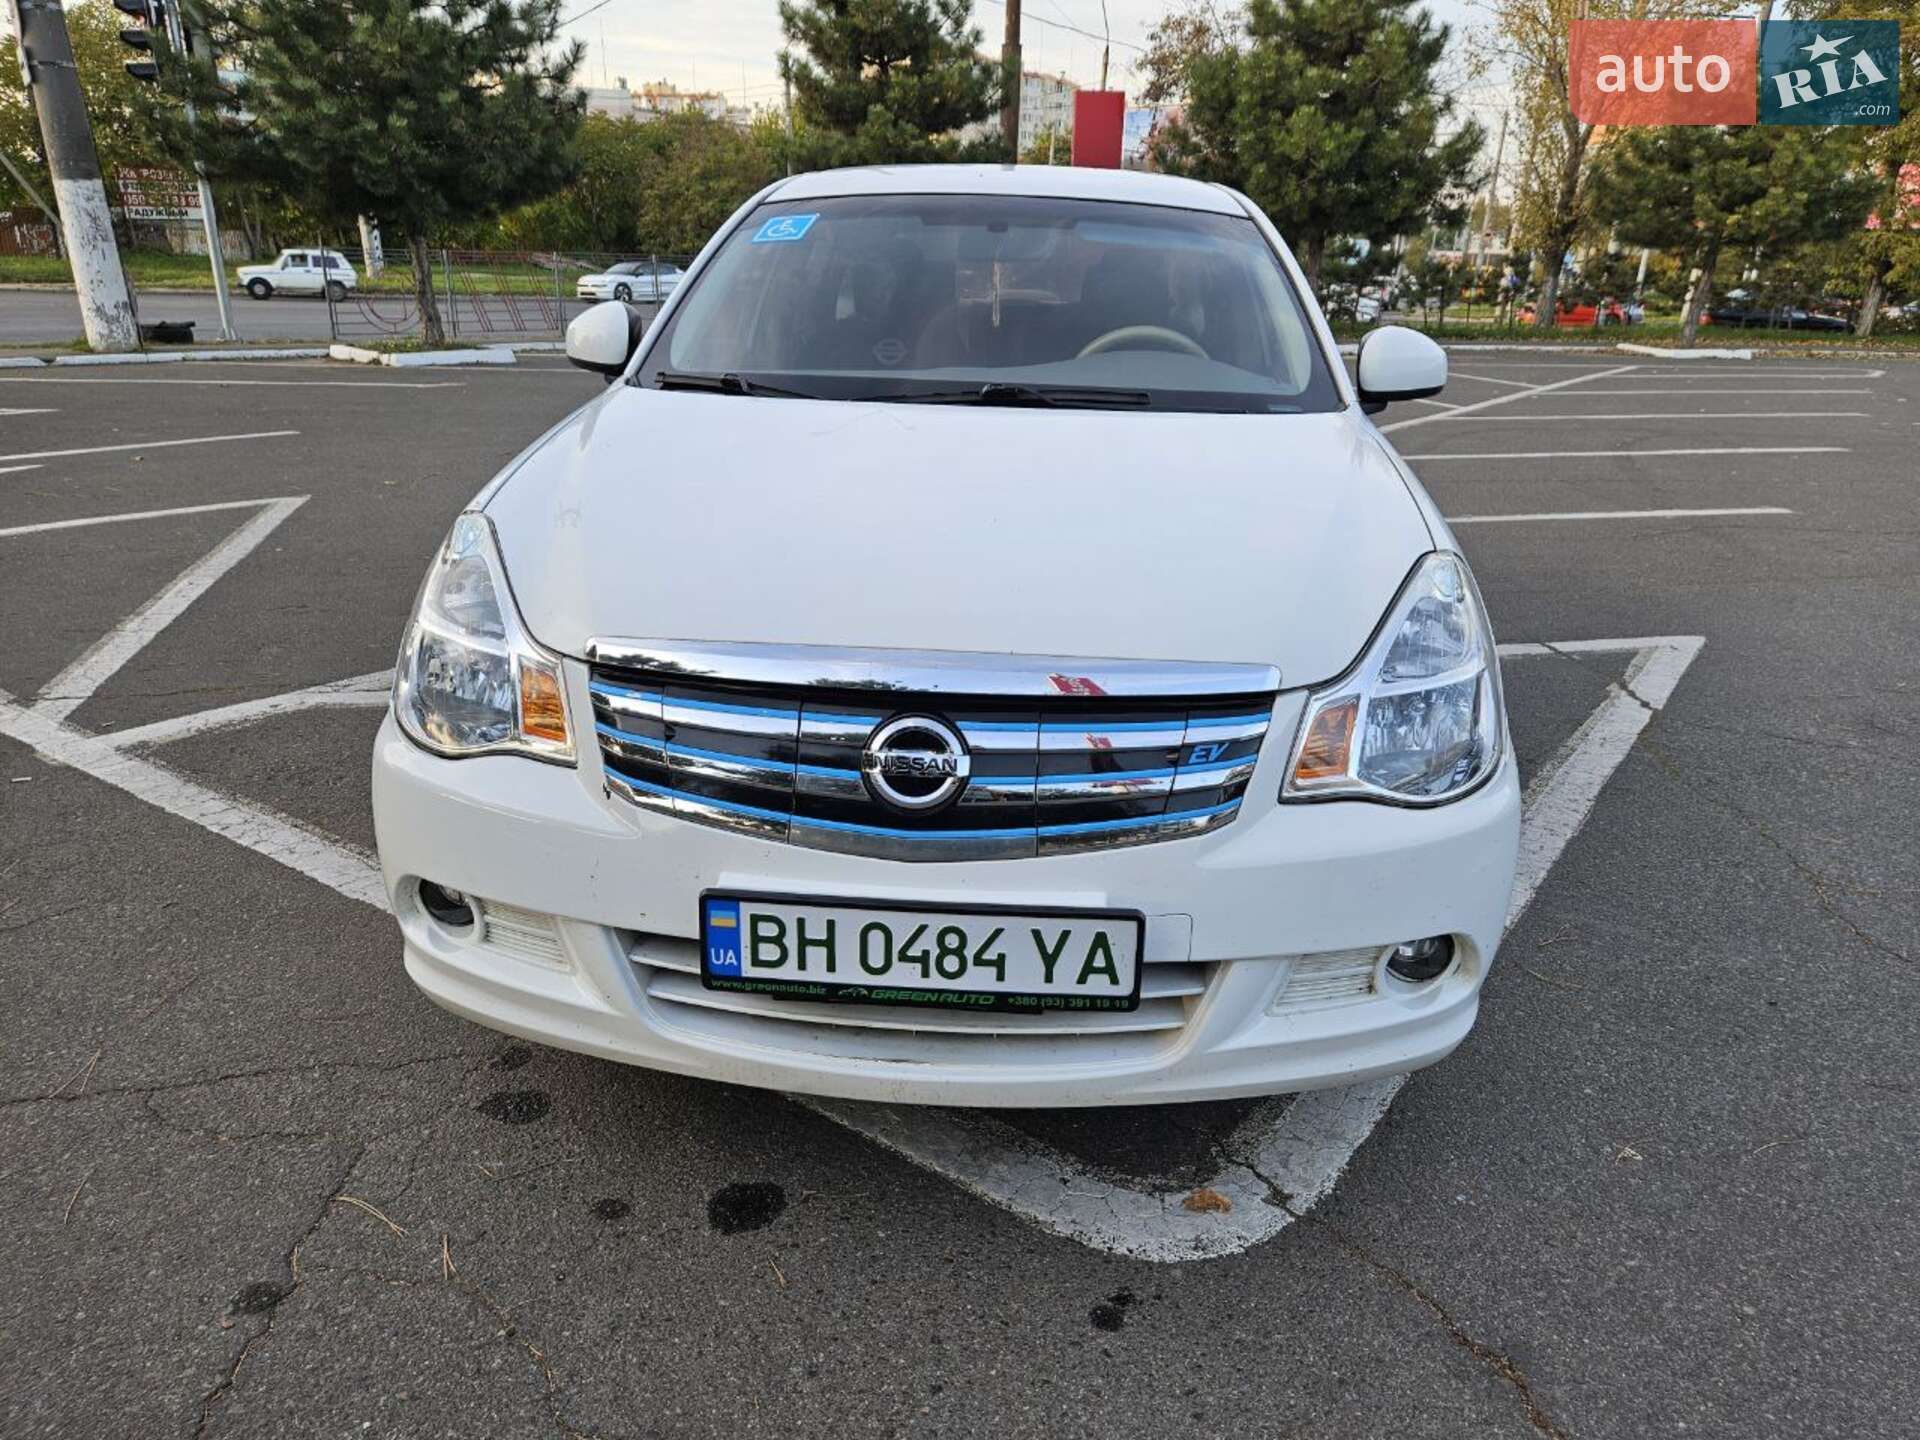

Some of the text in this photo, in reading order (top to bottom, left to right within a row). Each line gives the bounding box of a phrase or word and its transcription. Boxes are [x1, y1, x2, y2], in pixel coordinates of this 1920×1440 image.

[1188, 742, 1230, 764] EV
[873, 755, 958, 773] NISSAN
[711, 948, 737, 966] UA
[750, 913, 1120, 986] BH 0484 YA
